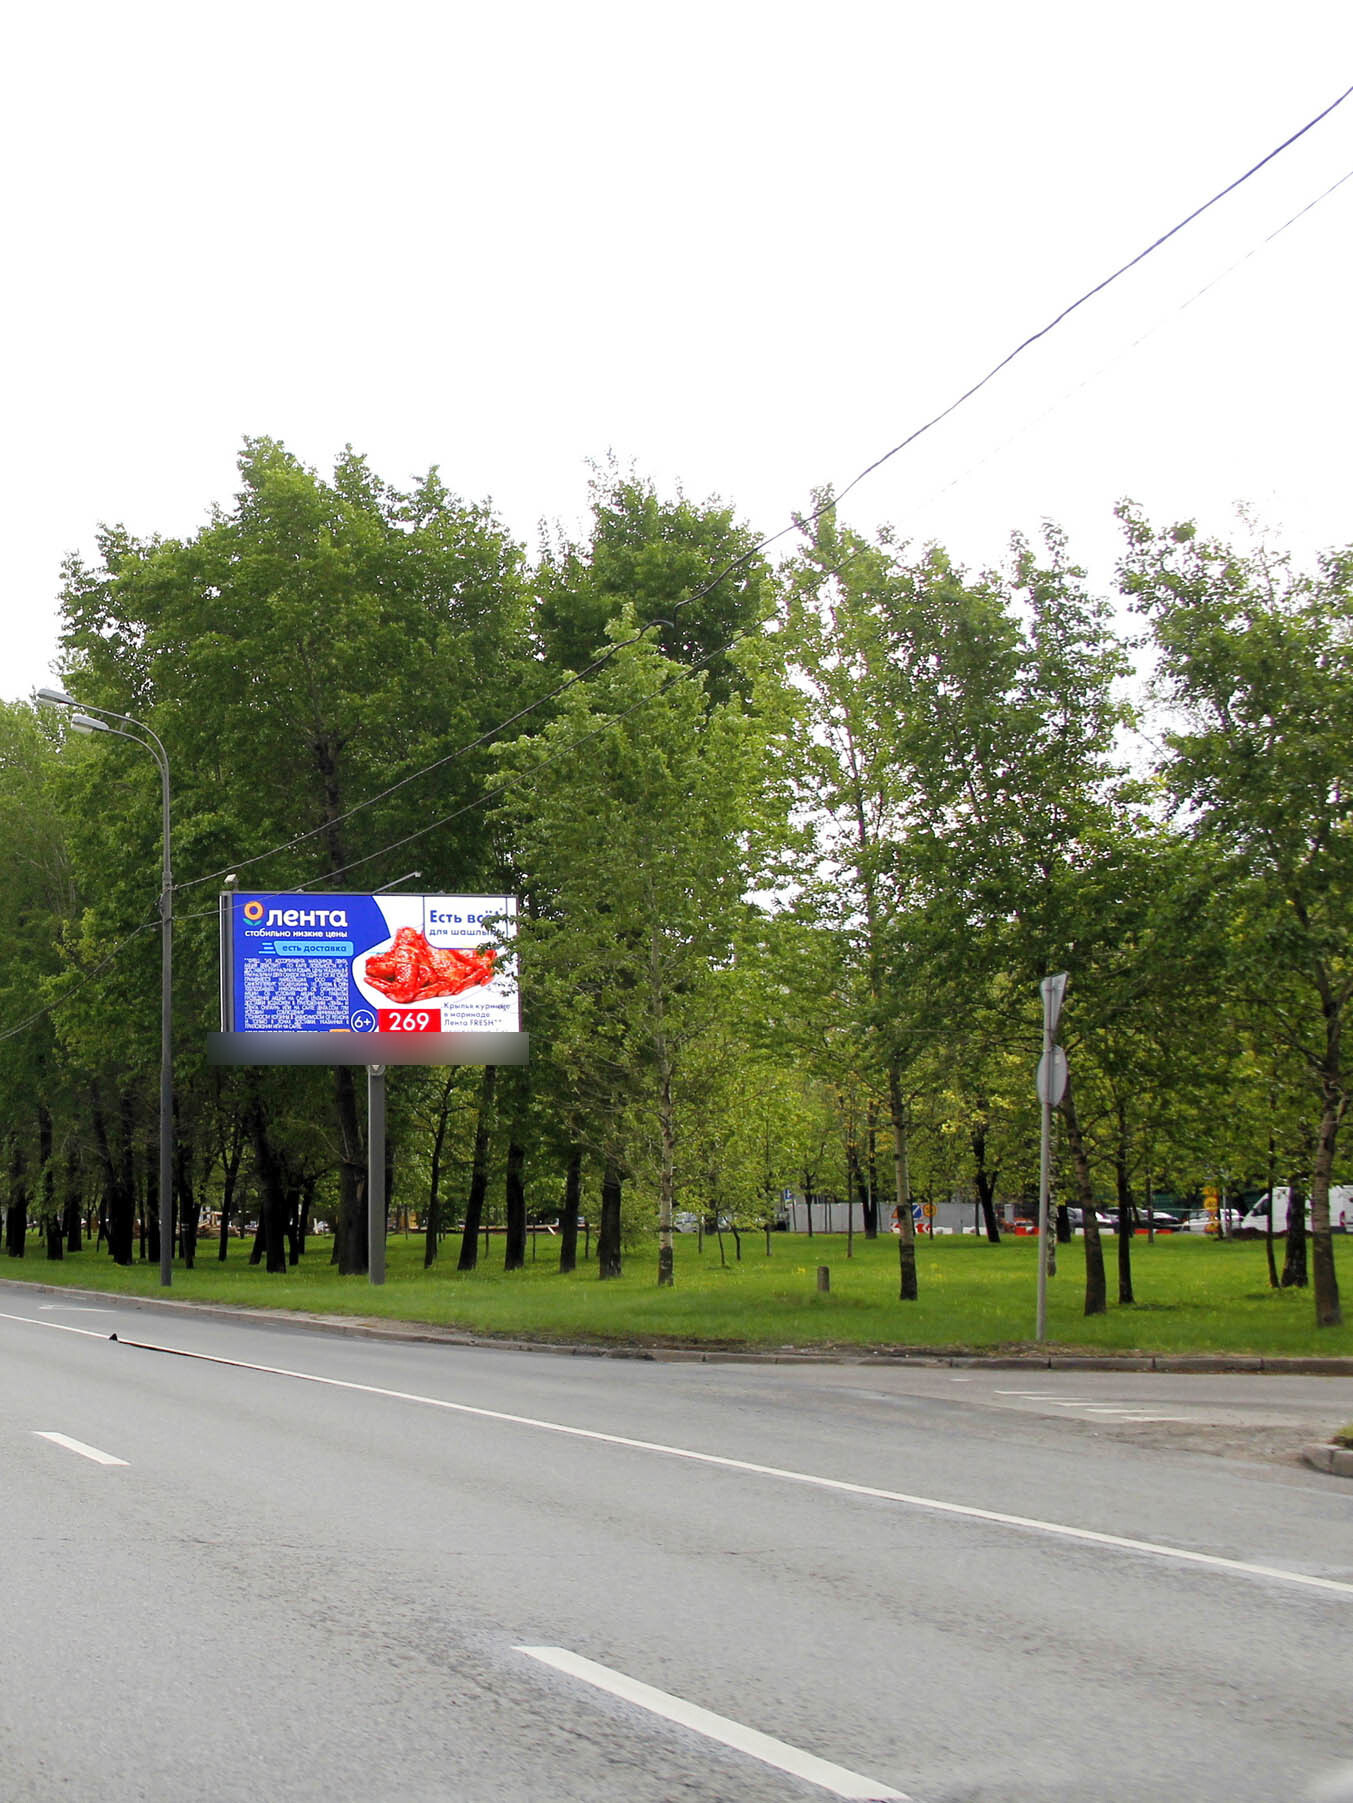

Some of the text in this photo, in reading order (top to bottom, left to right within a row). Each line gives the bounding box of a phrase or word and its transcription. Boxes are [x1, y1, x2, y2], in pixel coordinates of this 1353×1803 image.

[266, 909, 348, 927] лента
[430, 910, 462, 923] Есть
[245, 928, 291, 937] стабильно
[325, 930, 348, 938] цены
[304, 945, 347, 953] доставка
[444, 1002, 474, 1010] Крылья
[354, 1016, 372, 1028] 6+
[388, 1012, 429, 1031] 269
